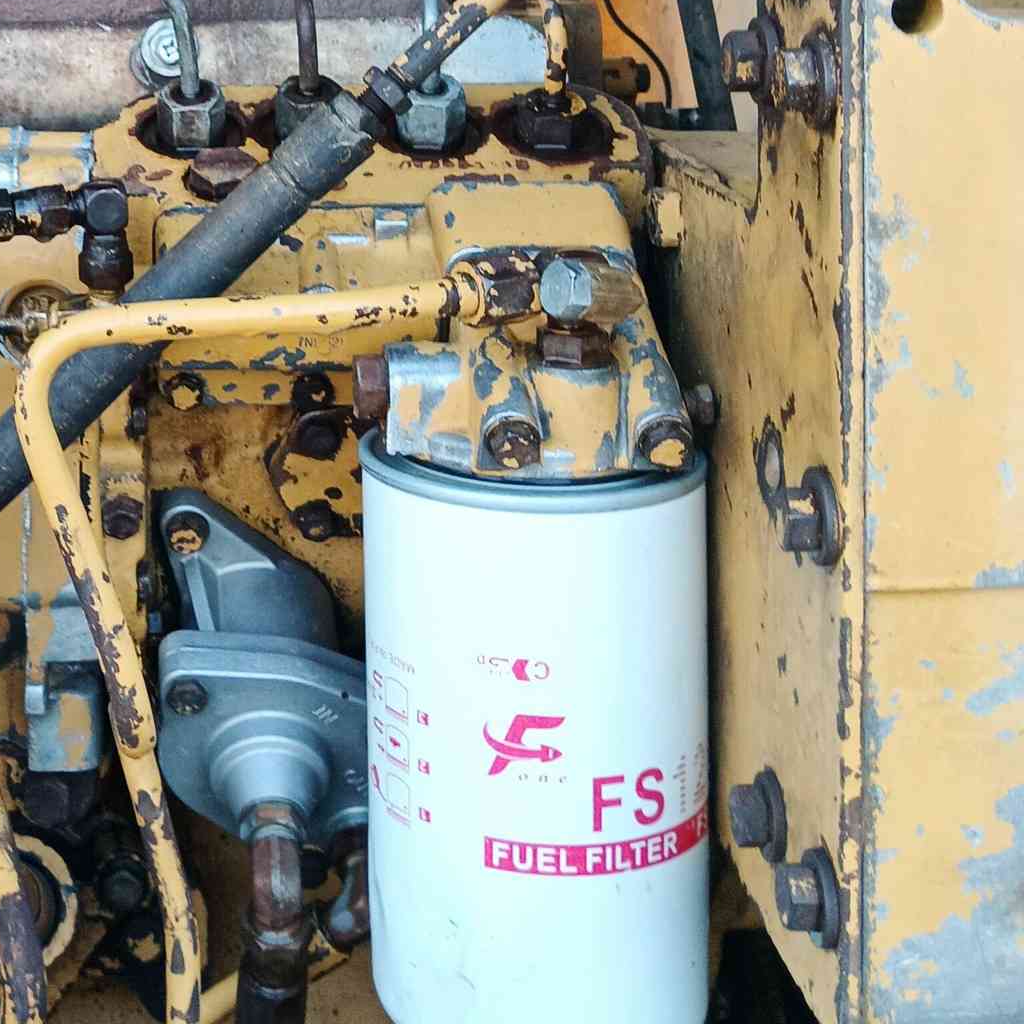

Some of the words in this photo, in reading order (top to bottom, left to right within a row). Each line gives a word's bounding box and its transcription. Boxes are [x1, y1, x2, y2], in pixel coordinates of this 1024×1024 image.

[592, 767, 666, 833] FS
[491, 842, 578, 874] FUEL
[585, 831, 678, 873] FILTER
